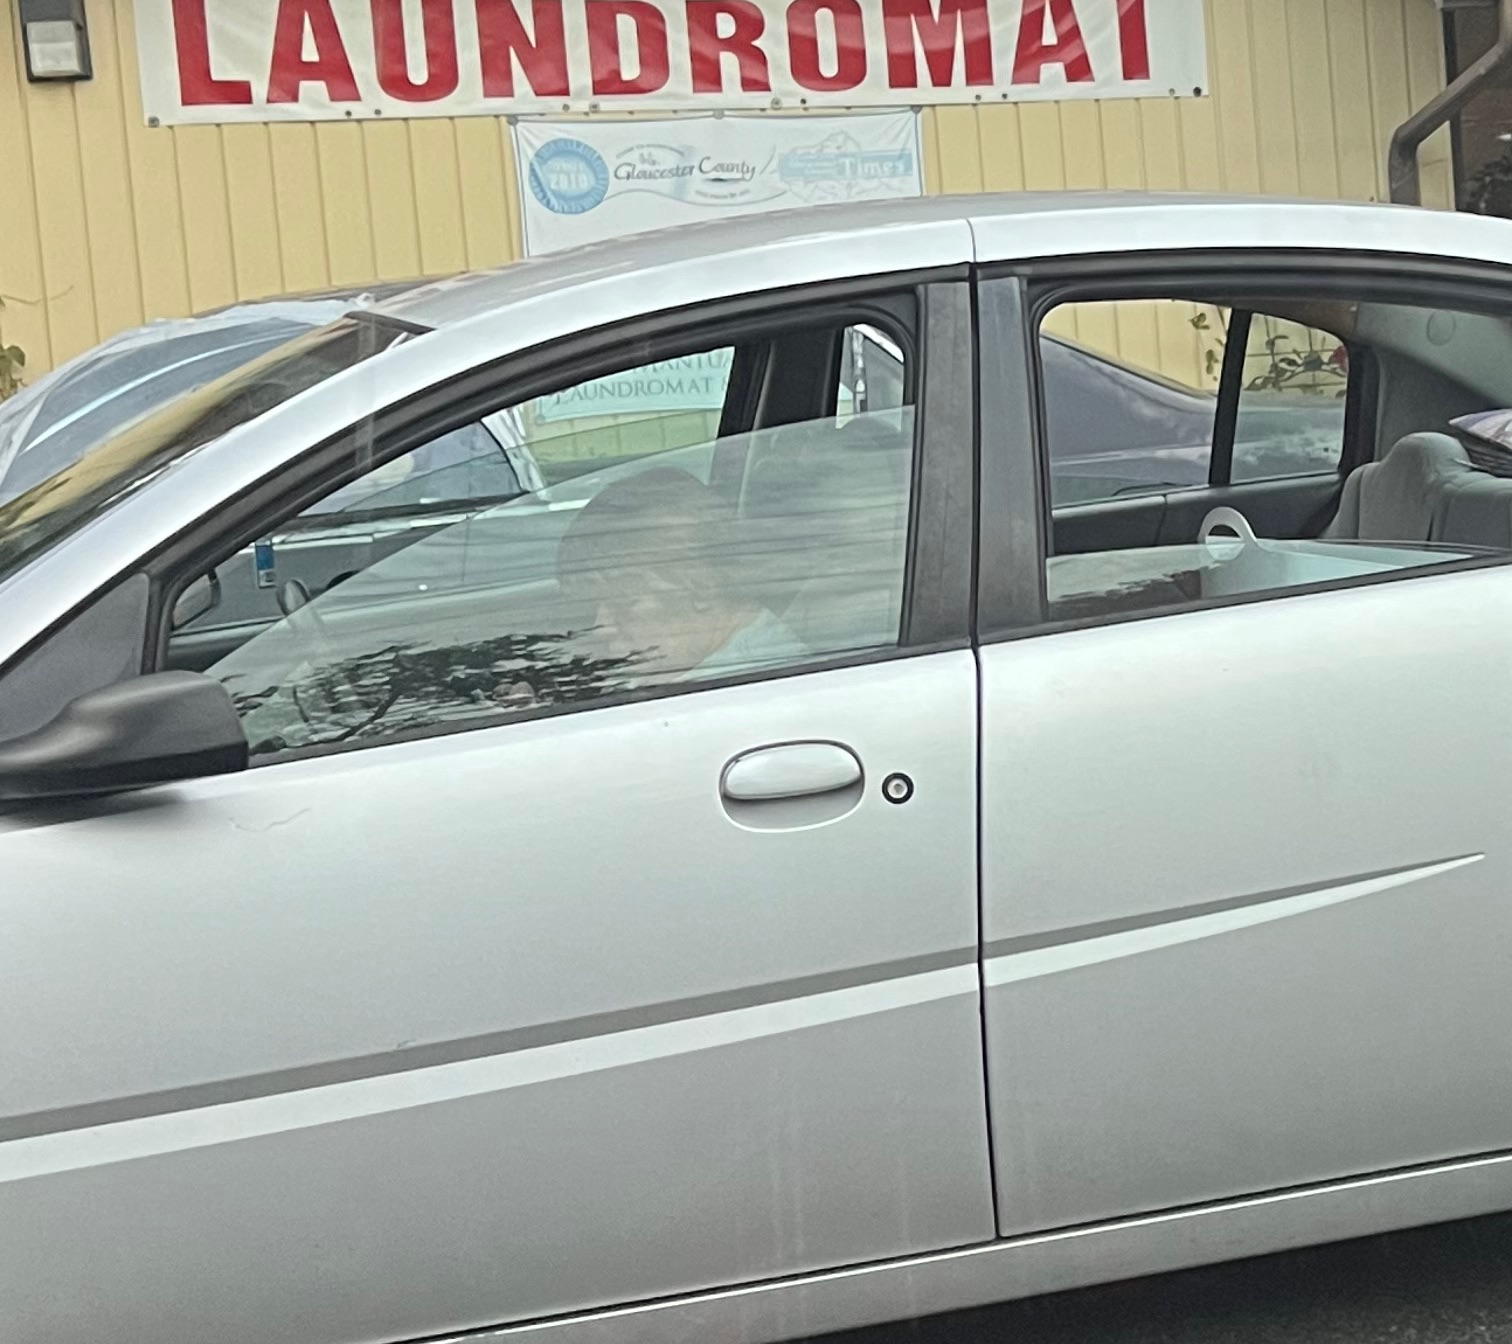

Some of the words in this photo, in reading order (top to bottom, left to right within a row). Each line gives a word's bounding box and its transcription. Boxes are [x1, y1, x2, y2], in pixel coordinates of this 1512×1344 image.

[613, 162, 696, 181] Gloucester
[698, 156, 756, 182] County
[554, 377, 714, 406] LAUNDROMAT
